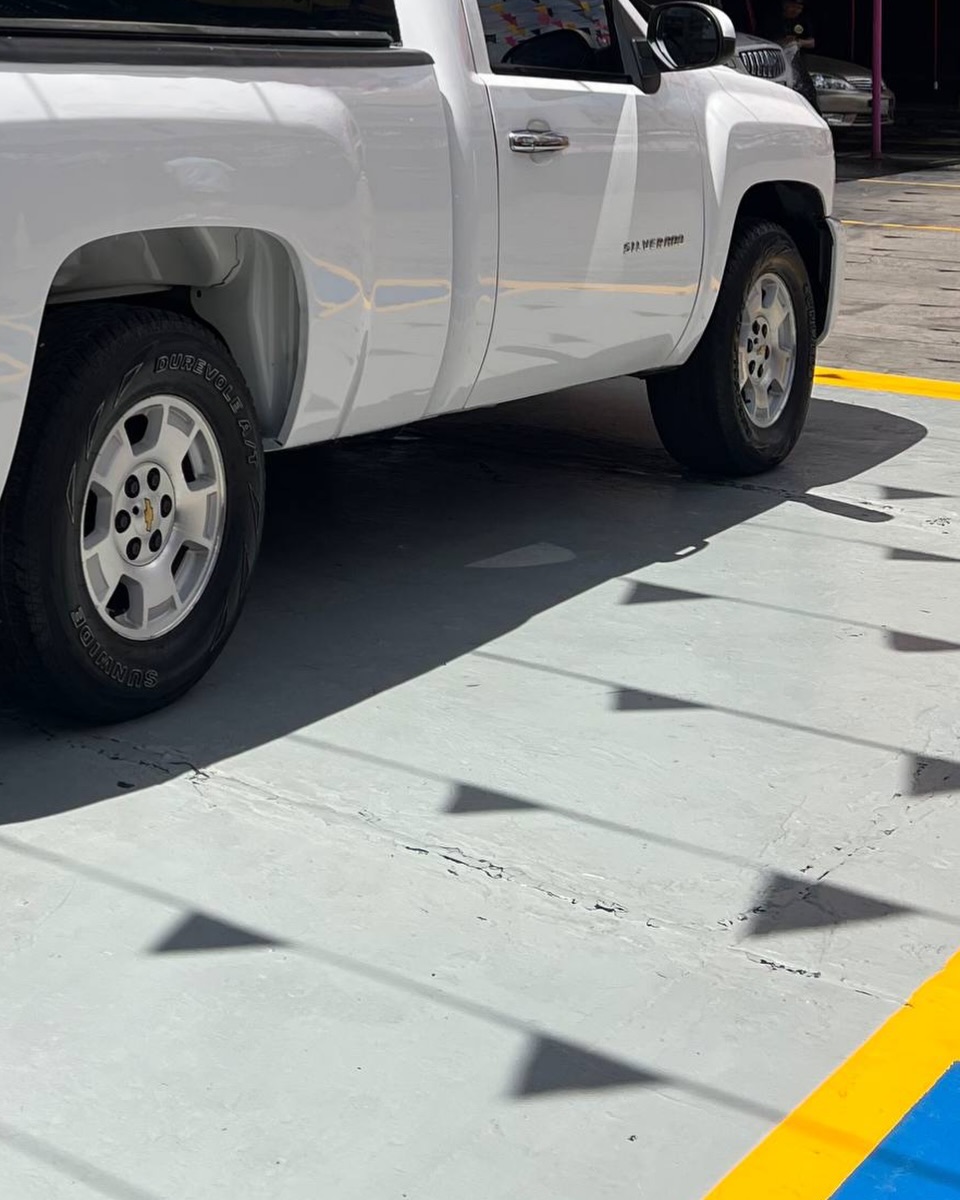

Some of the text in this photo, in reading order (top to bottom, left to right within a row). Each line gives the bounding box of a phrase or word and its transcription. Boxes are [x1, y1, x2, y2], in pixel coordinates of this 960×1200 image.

[623, 234, 684, 254] SILVERADO
[155, 353, 243, 413] DUREVOLE
[70, 606, 159, 688] SUNWIDE
